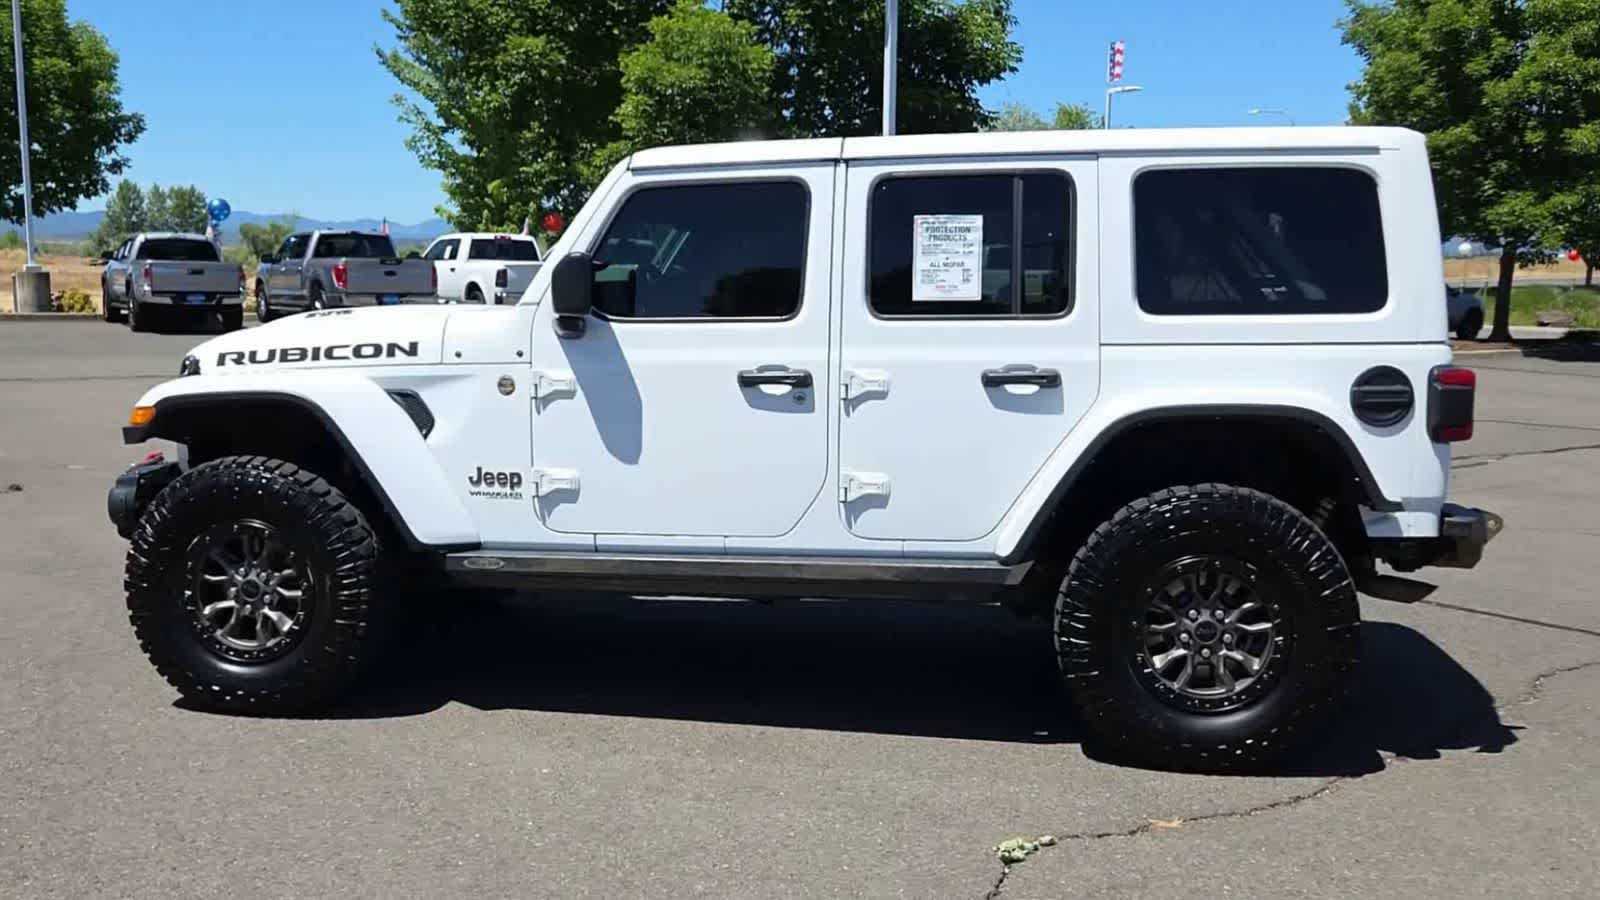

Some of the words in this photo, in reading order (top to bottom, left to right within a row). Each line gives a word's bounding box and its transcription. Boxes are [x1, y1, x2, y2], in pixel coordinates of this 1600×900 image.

[925, 225, 971, 233] PROTECTION
[216, 341, 419, 367] RUBICON
[468, 466, 523, 491] Jeep
